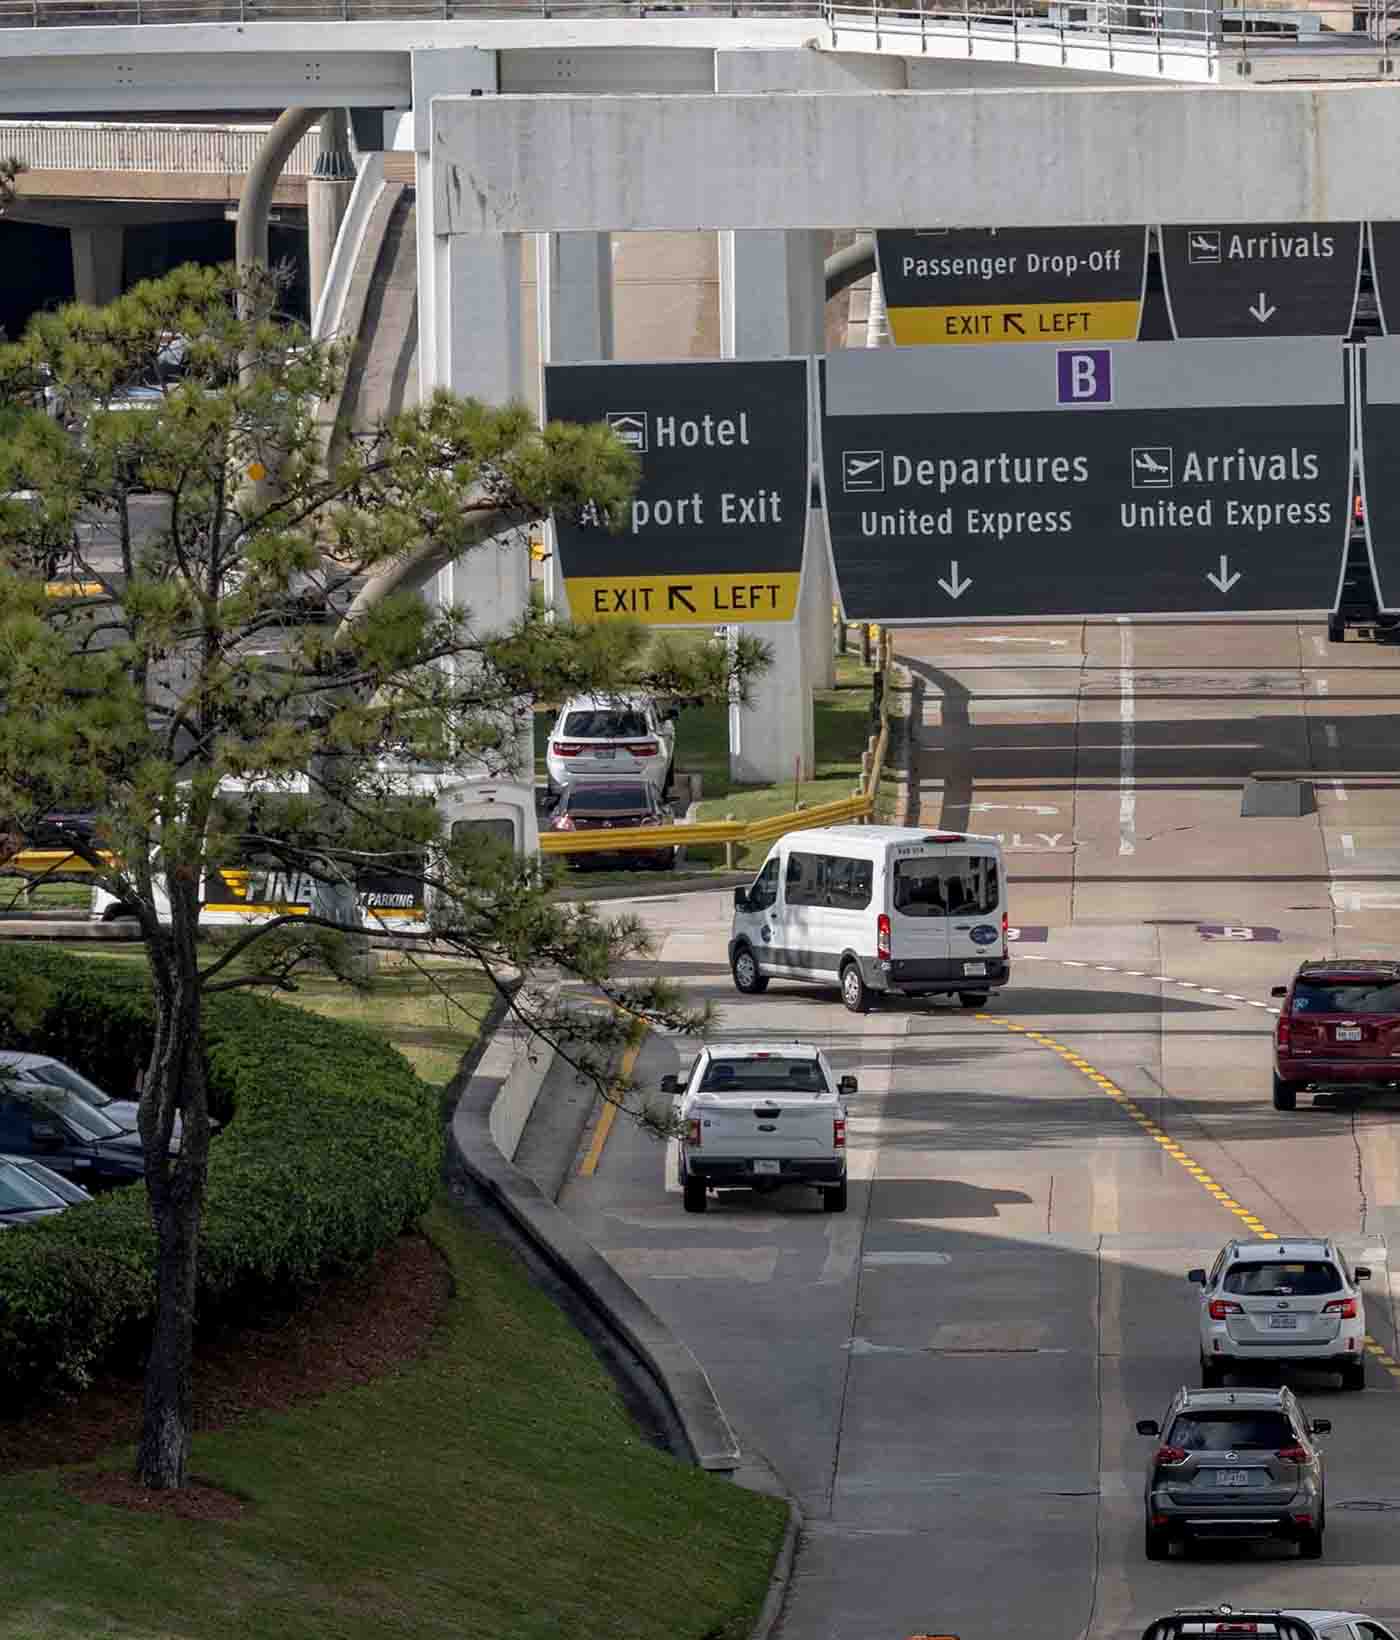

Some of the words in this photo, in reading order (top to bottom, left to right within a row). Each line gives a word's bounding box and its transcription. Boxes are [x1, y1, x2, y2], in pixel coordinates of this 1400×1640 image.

[1229, 232, 1334, 259] Arrivals
[902, 256, 1017, 280] Passenger
[1027, 250, 1121, 276] Drop-Off
[946, 315, 993, 335] EXIT
[1039, 312, 1092, 332] LEFT
[1072, 355, 1097, 398] B
[656, 412, 750, 447] Hotel
[893, 452, 1089, 492] Departures
[1183, 447, 1319, 482] Arrivals
[579, 492, 704, 534] Aport
[721, 489, 782, 524] Exit
[861, 507, 953, 537] United
[967, 509, 1072, 540] Express
[1120, 498, 1213, 528] United
[1226, 500, 1331, 531] Express
[594, 586, 654, 613] EXIT
[713, 584, 781, 609] LEFT
[367, 892, 415, 908] PARKING
